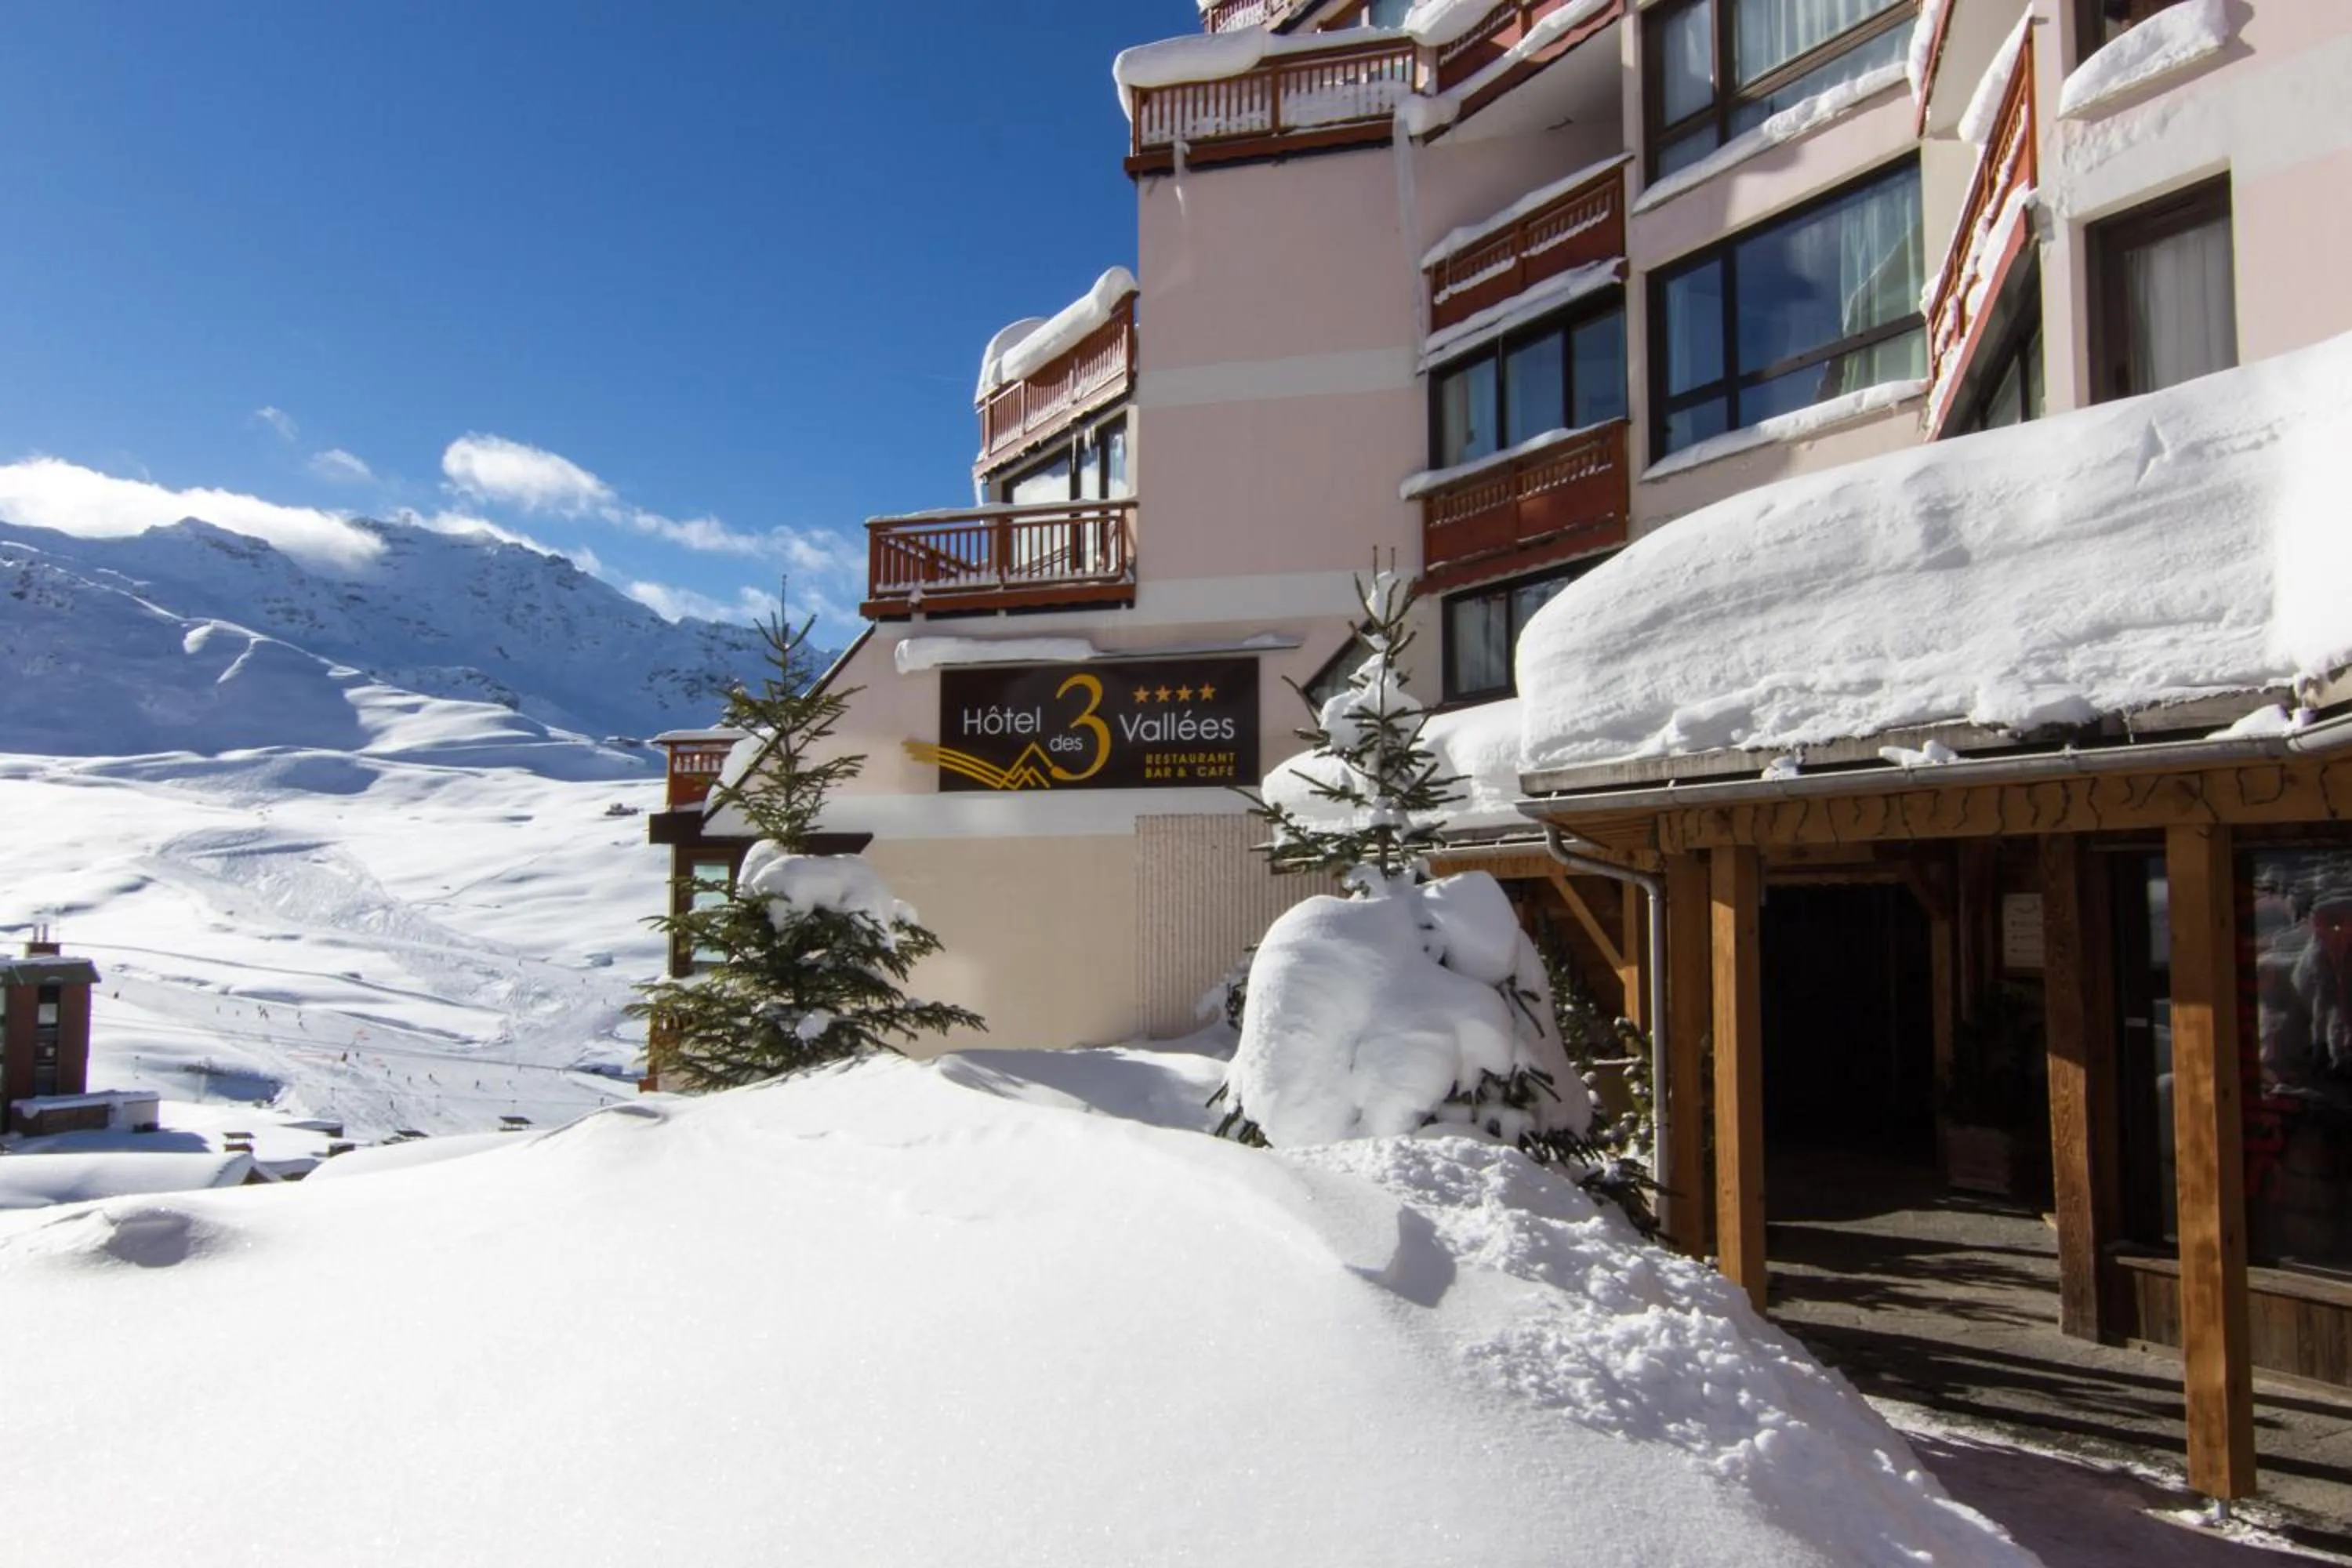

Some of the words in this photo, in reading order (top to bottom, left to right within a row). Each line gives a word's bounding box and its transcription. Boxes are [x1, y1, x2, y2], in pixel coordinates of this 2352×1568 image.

[963, 706, 1042, 735] Hôtel
[1051, 672, 1112, 781] 3
[1119, 710, 1236, 742] Vallées
[1050, 735, 1083, 753] des
[1145, 752, 1236, 765] RESTAURANT
[1145, 767, 1172, 779] BAR
